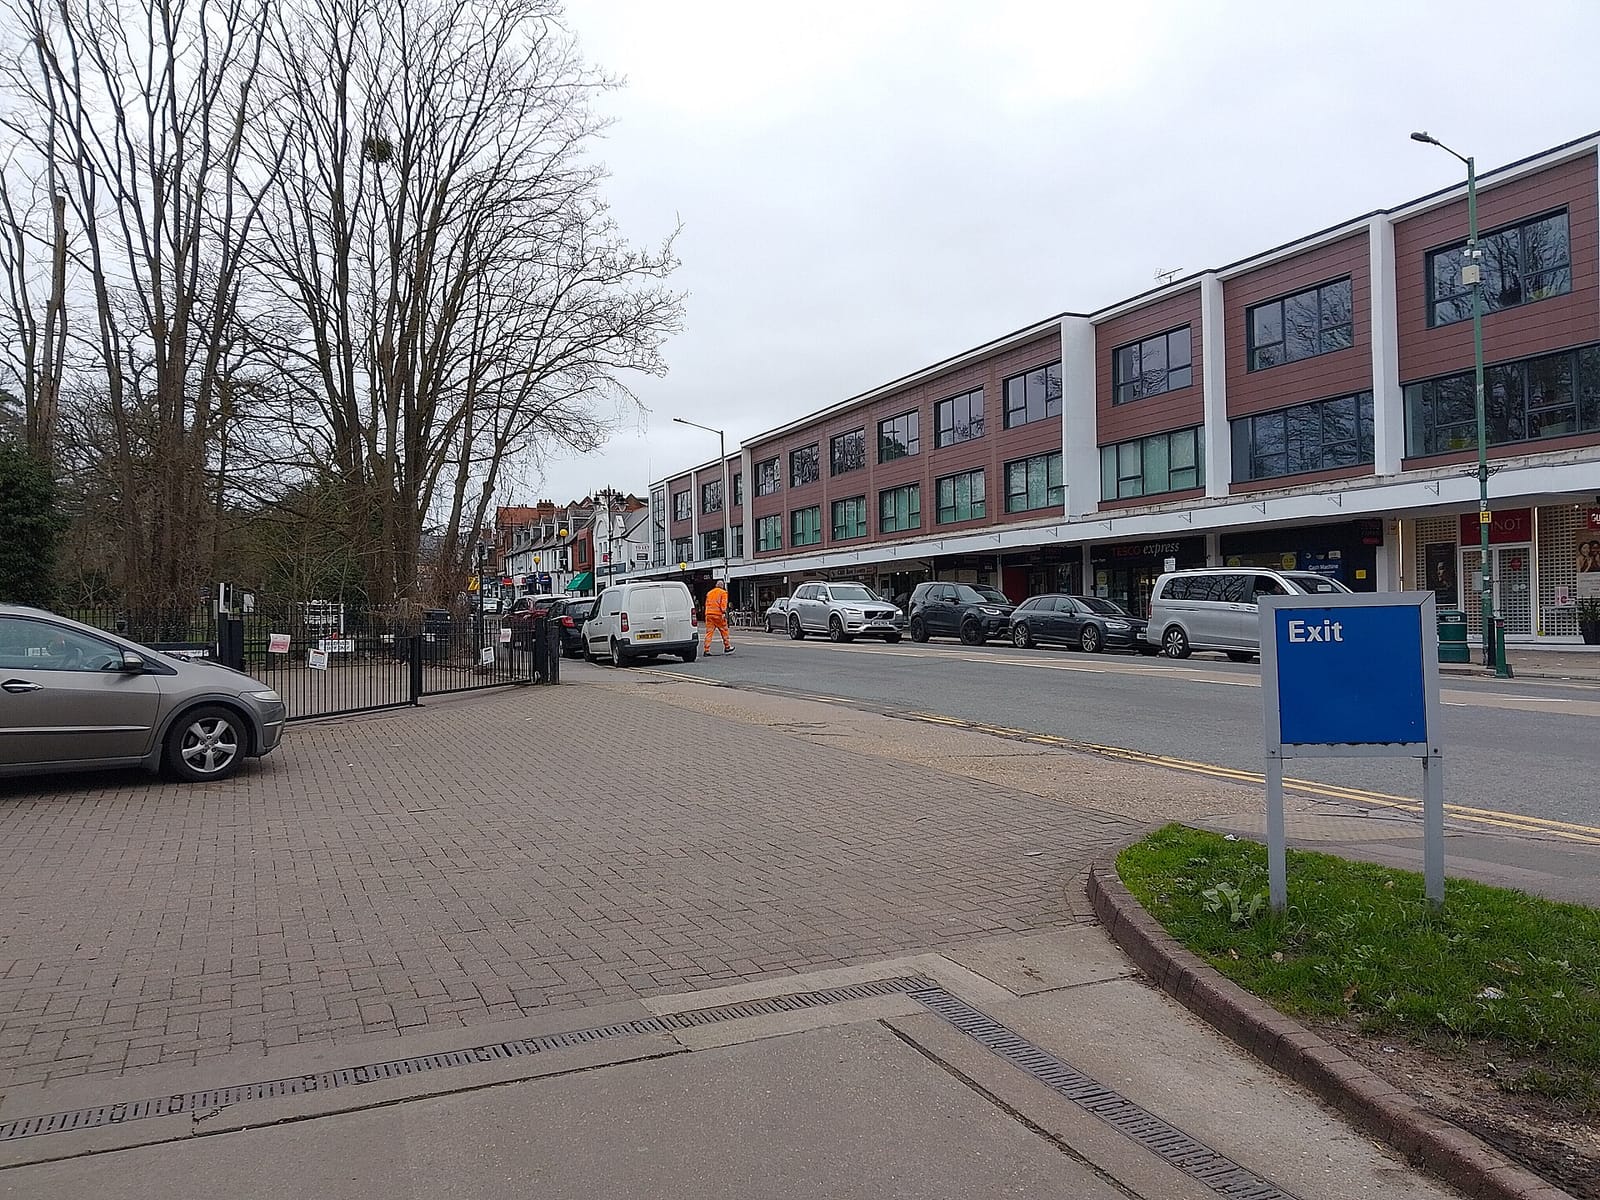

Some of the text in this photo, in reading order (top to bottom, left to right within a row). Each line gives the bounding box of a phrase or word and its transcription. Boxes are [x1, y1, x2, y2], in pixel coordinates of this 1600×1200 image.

[1472, 518, 1522, 531] GINOT
[1112, 542, 1180, 557] TESCO express
[1288, 620, 1344, 643] Exit
